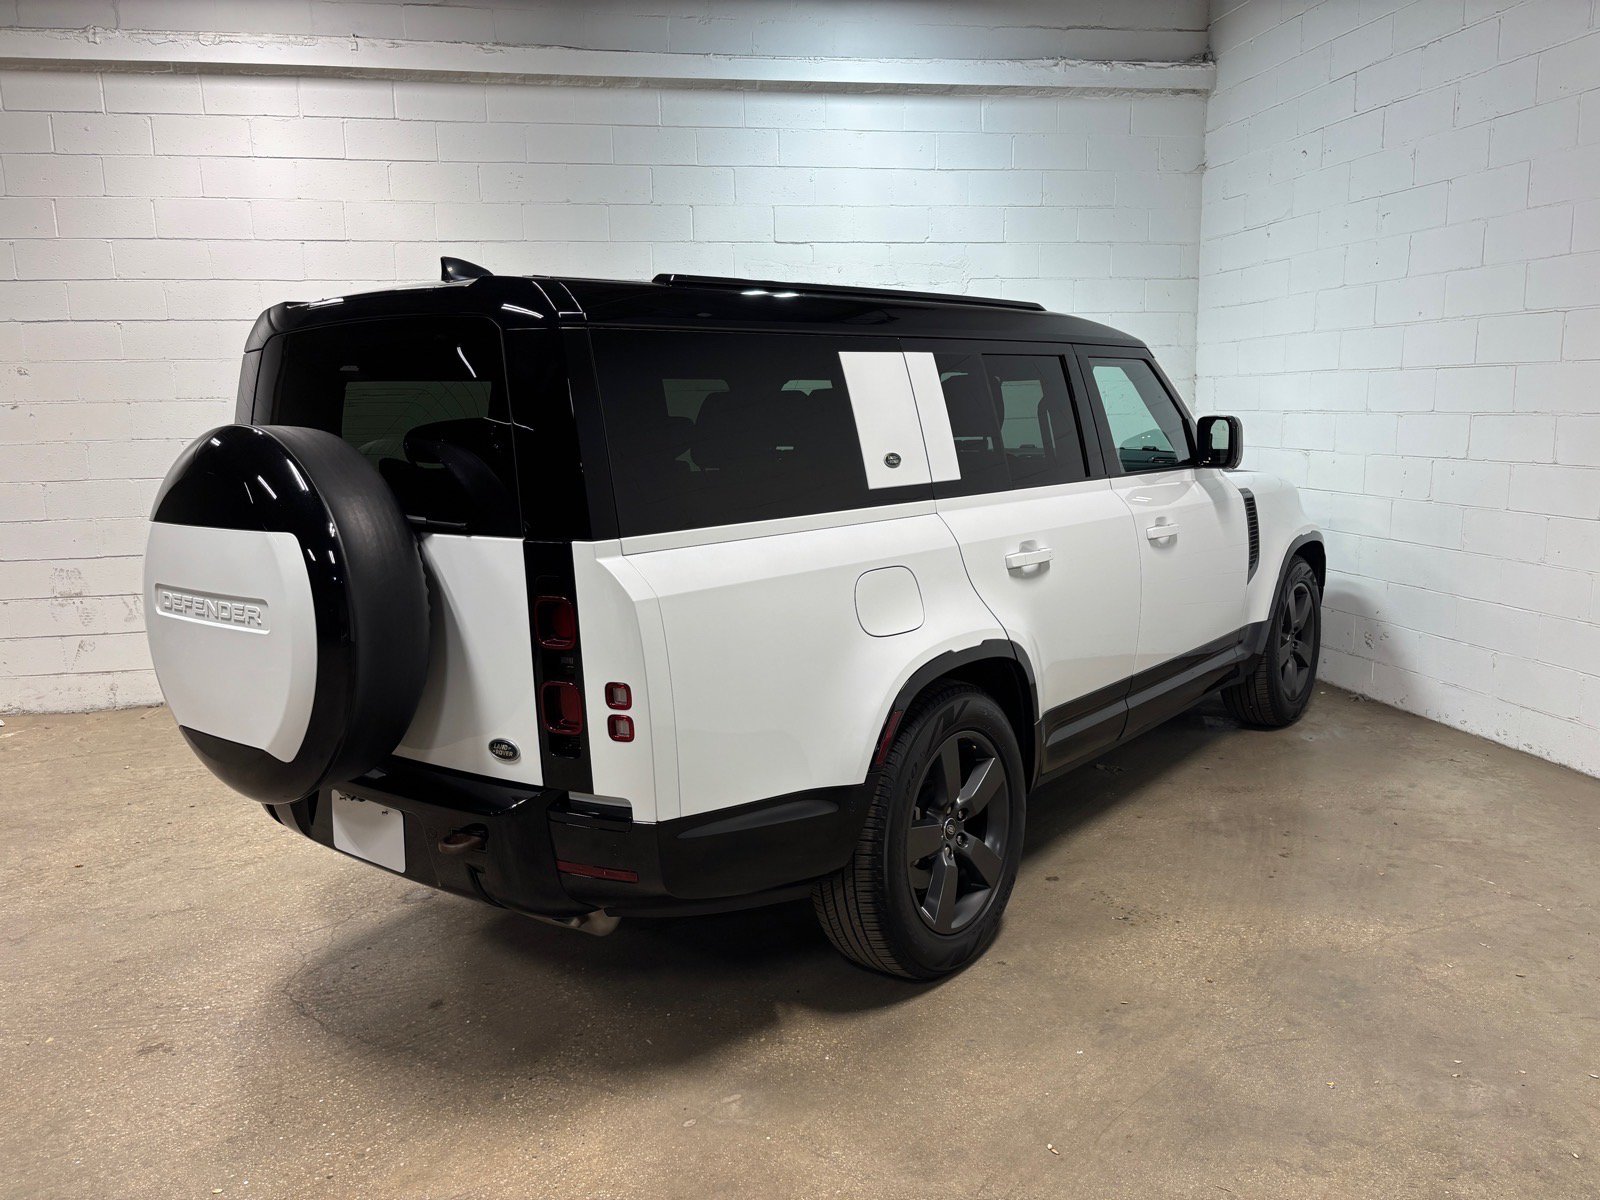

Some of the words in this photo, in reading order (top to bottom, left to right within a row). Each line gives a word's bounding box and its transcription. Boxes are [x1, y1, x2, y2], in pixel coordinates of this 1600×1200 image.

[162, 591, 262, 626] DEFENDER
[493, 743, 508, 751] LAND
[495, 749, 513, 757] ROVER
